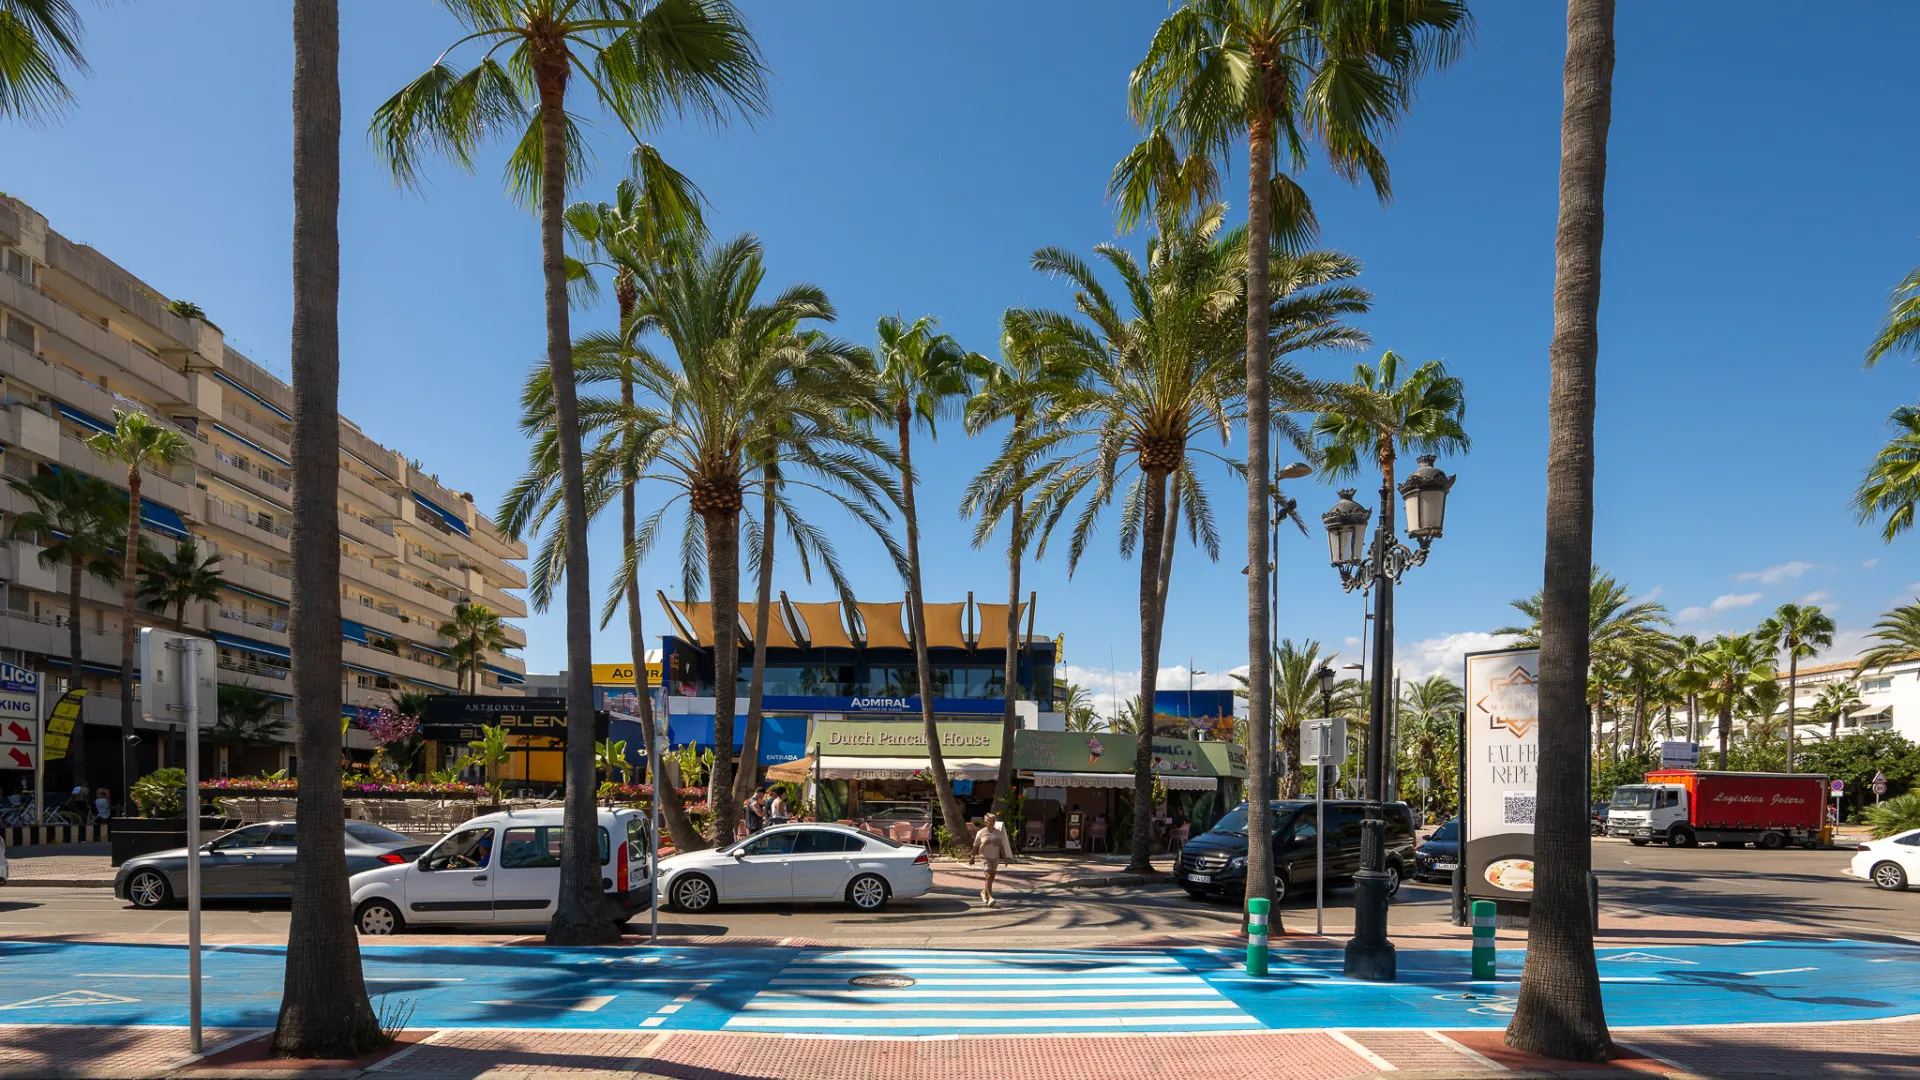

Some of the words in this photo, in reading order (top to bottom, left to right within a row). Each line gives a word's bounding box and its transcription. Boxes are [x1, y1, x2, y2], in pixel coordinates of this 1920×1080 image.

[0, 664, 36, 684] LICO
[465, 703, 526, 711] ANTHONY'S
[851, 697, 911, 709] ADMIRAL
[500, 715, 568, 727] BLEN
[829, 732, 875, 746] Dutch
[878, 732, 928, 746] Pancak
[942, 732, 991, 747] House
[1492, 765, 1538, 784] REPE
[1041, 776, 1068, 785] Dutch
[1071, 777, 1106, 787] Pancake
